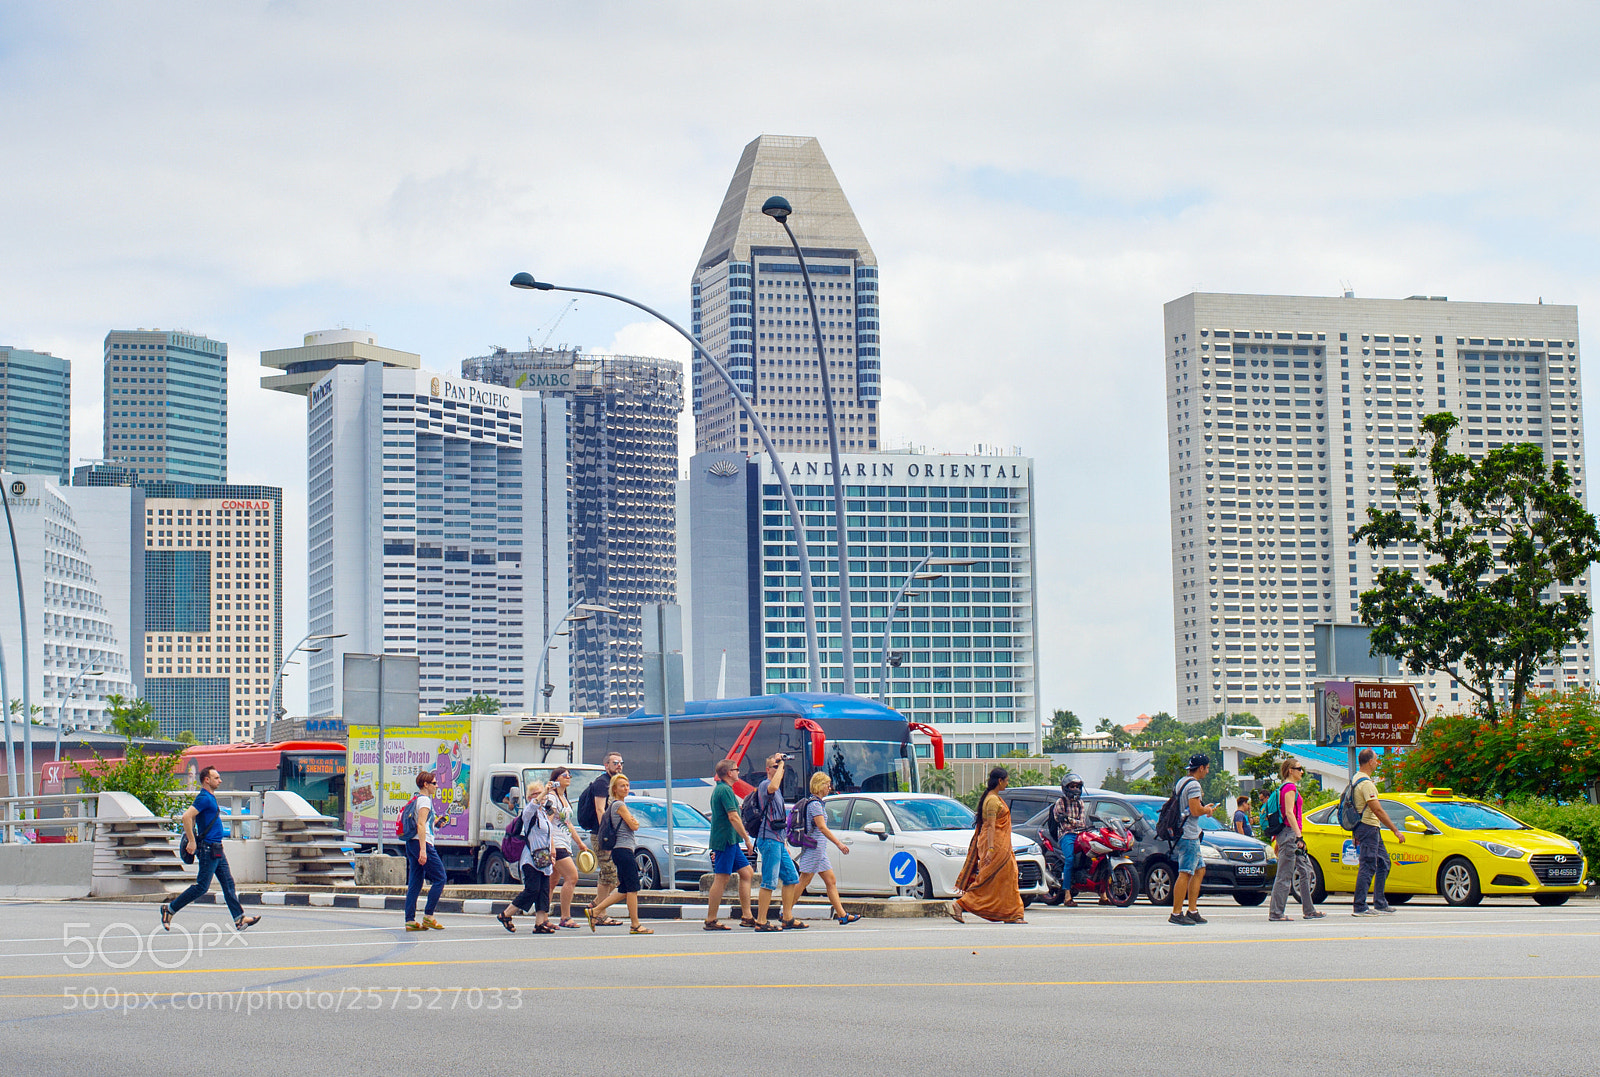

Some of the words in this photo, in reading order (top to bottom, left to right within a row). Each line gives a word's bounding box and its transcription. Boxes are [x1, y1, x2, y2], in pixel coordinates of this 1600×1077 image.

[529, 373, 570, 387] SMBC
[444, 381, 466, 400] PAN
[469, 386, 510, 409] PACIFIC
[908, 463, 1021, 479] ORIENTAL
[221, 500, 270, 510] CONRAD
[1358, 688, 1381, 698] Merlion
[1383, 688, 1397, 699] Park
[1359, 711, 1374, 719] Taman
[1375, 711, 1393, 719] Merlion
[306, 720, 347, 731] MARI
[352, 751, 380, 765] Japanes
[385, 750, 407, 764] Sweet
[407, 750, 430, 764] Potato
[306, 764, 334, 773] SHENTON
[47, 766, 60, 784] SK
